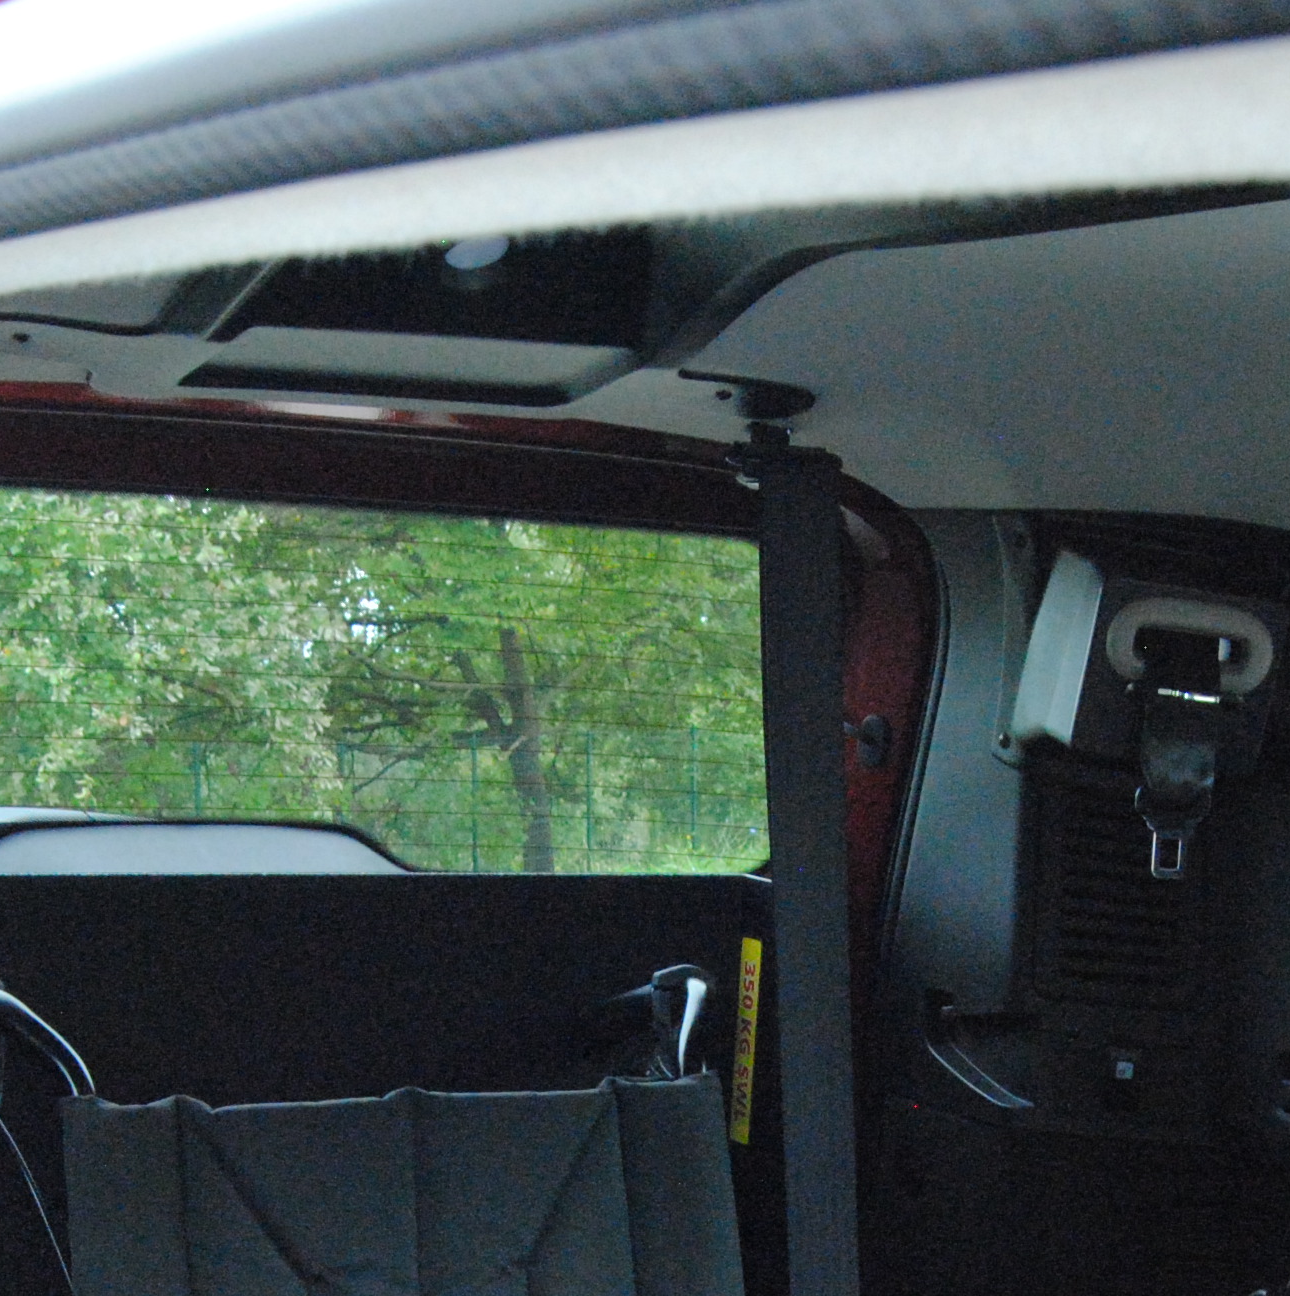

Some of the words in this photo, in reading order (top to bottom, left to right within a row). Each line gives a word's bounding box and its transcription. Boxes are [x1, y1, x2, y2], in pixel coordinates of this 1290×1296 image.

[740, 961, 756, 1010] 350
[737, 1018, 752, 1056] KG
[733, 1065, 750, 1121] SWL
